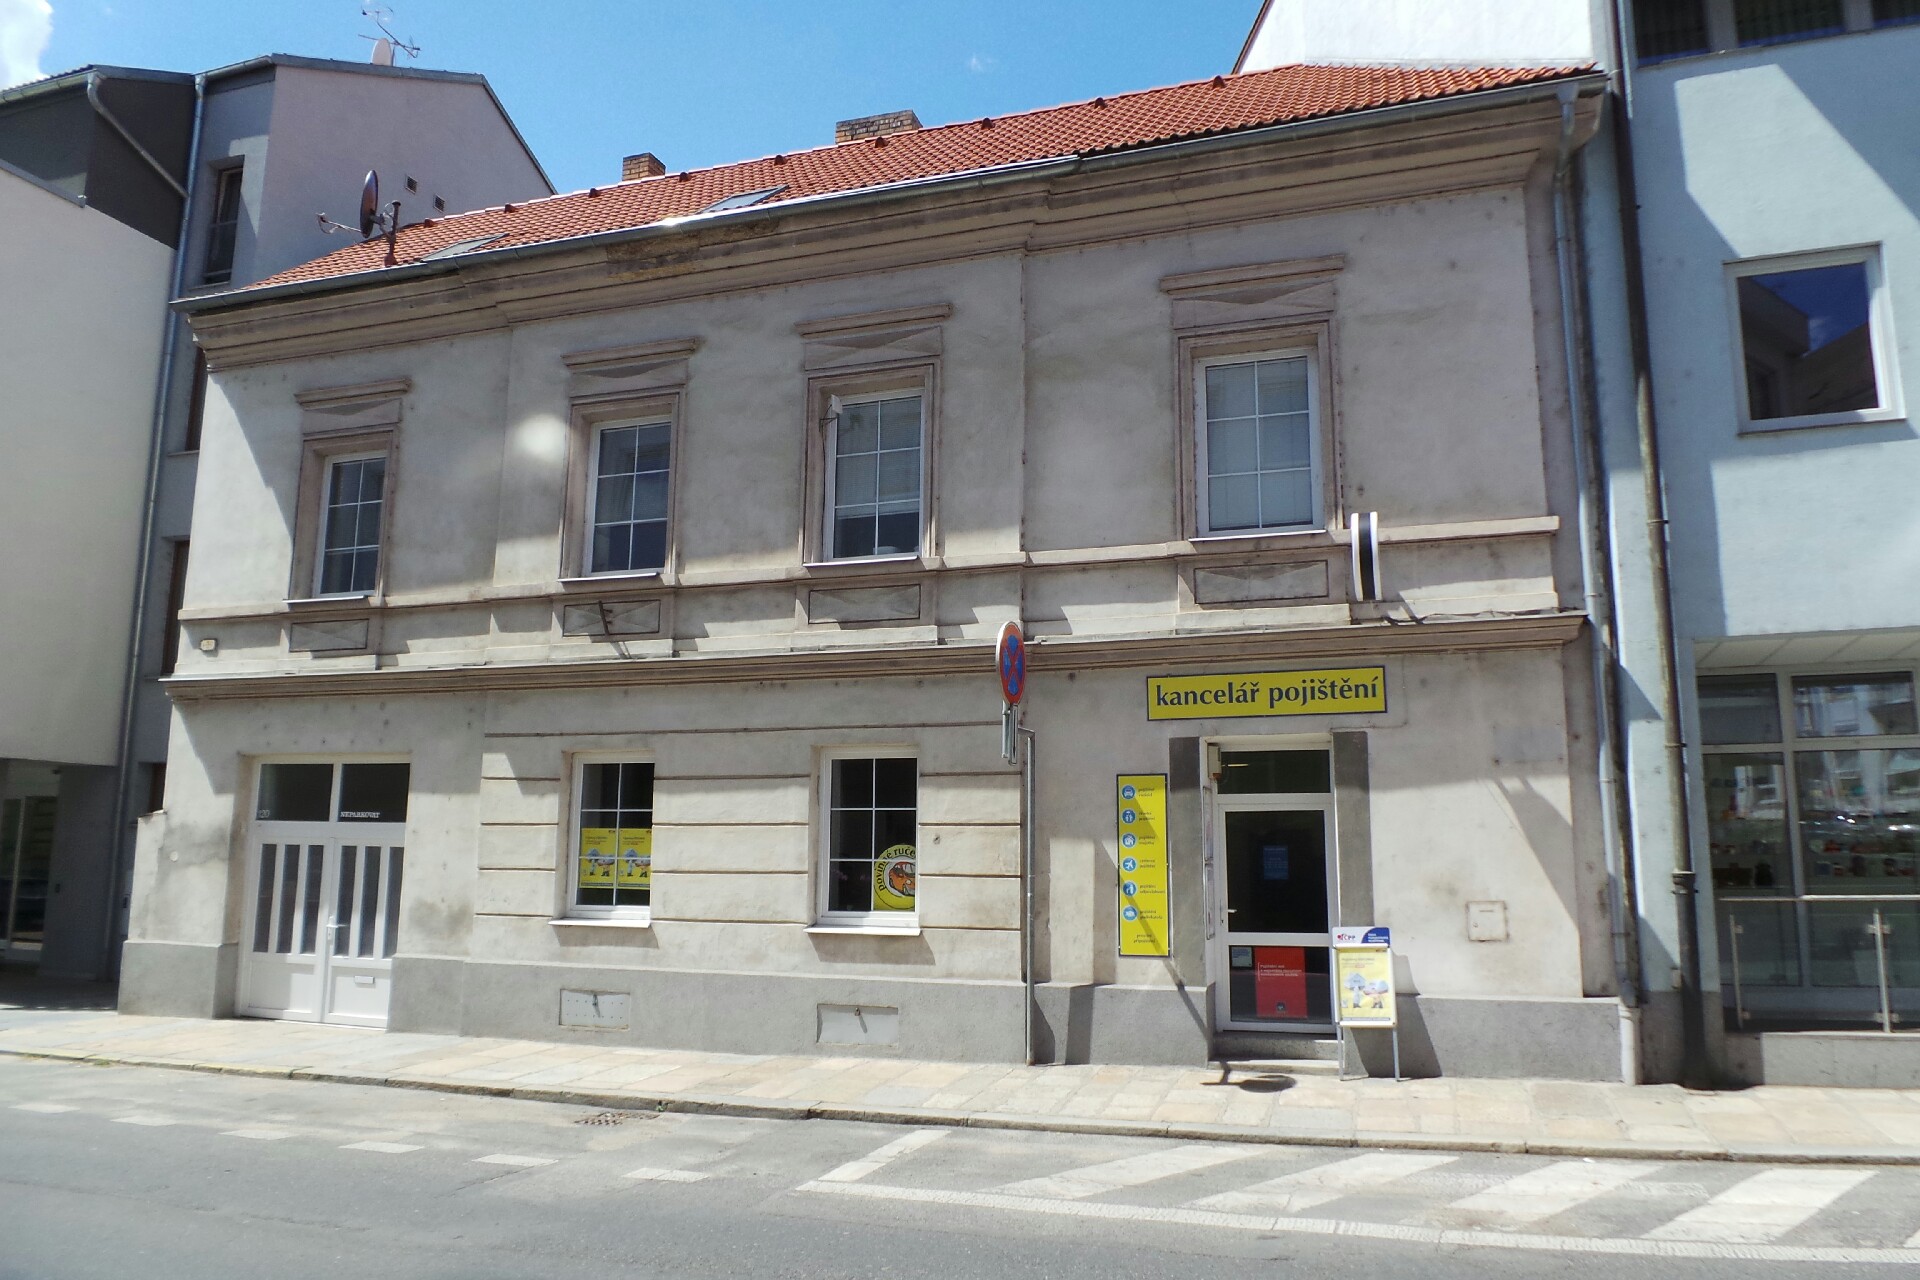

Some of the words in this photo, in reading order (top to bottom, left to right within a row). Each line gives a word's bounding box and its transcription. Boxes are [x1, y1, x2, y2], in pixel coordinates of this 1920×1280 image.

[1156, 681, 1260, 706] kancelář
[1269, 676, 1379, 709] pojištění
[340, 811, 381, 819] NEPARKOVAT
